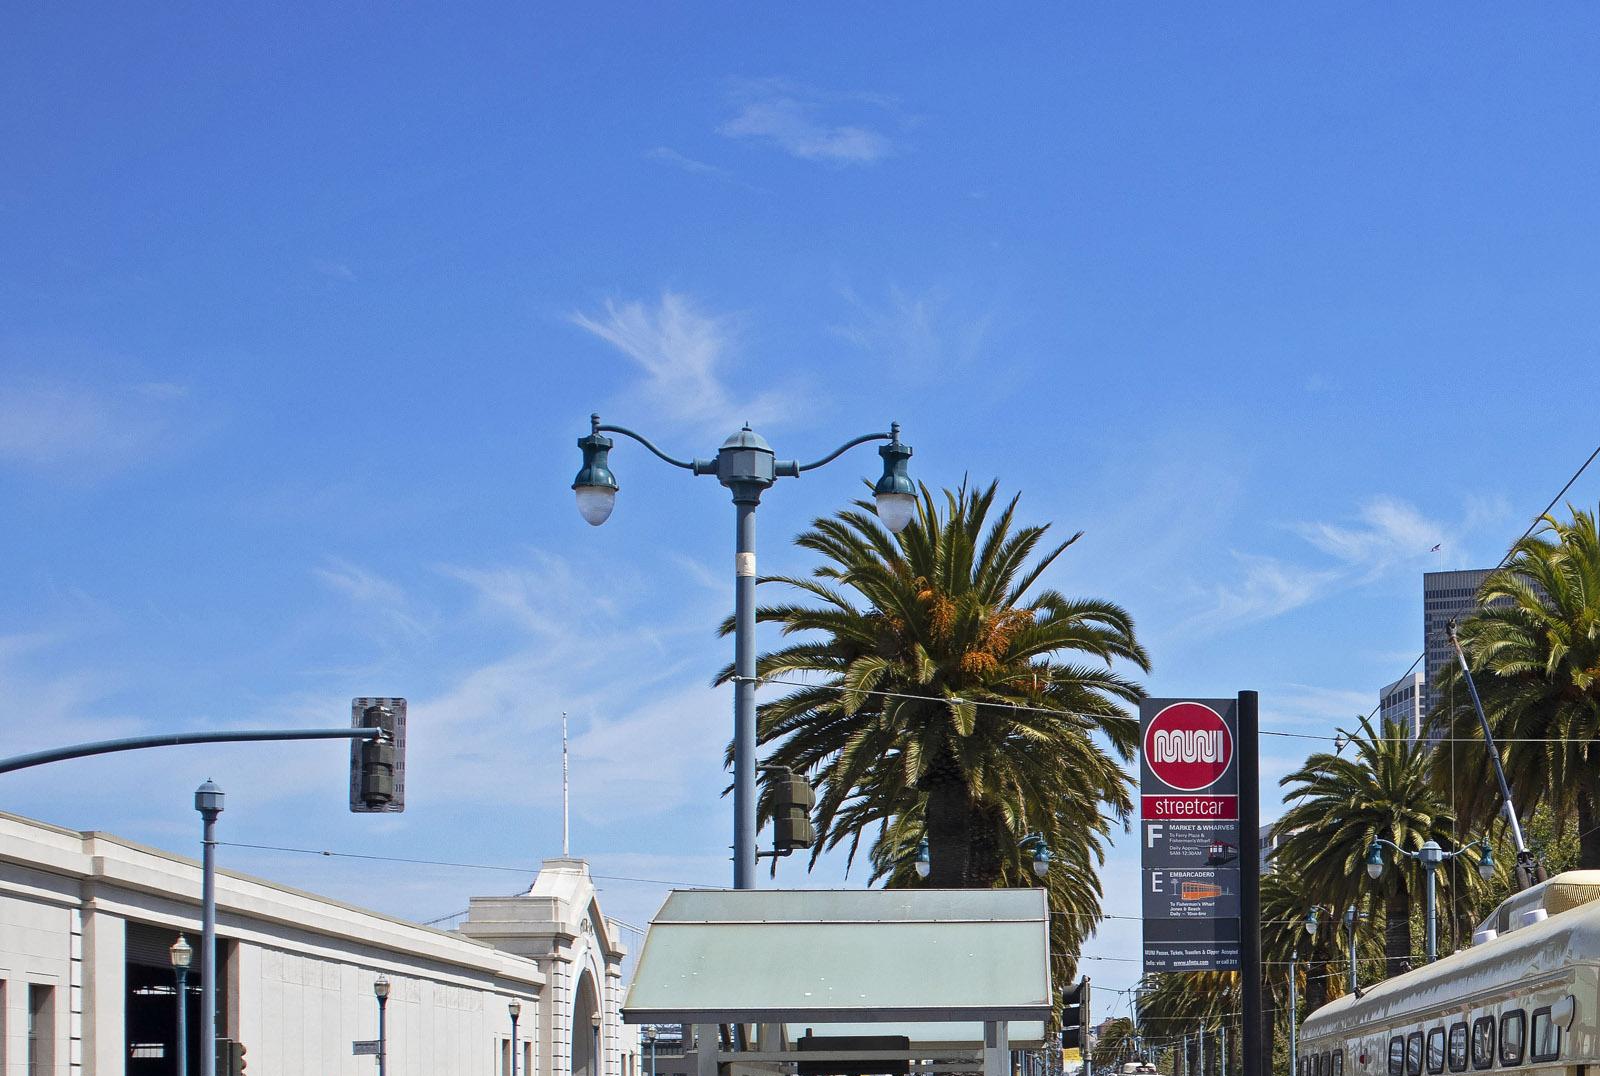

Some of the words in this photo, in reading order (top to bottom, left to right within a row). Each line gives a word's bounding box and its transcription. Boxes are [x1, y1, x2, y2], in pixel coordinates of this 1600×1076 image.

[1155, 799, 1224, 815] streetcar
[1147, 824, 1163, 848] F
[1152, 871, 1163, 893] E
